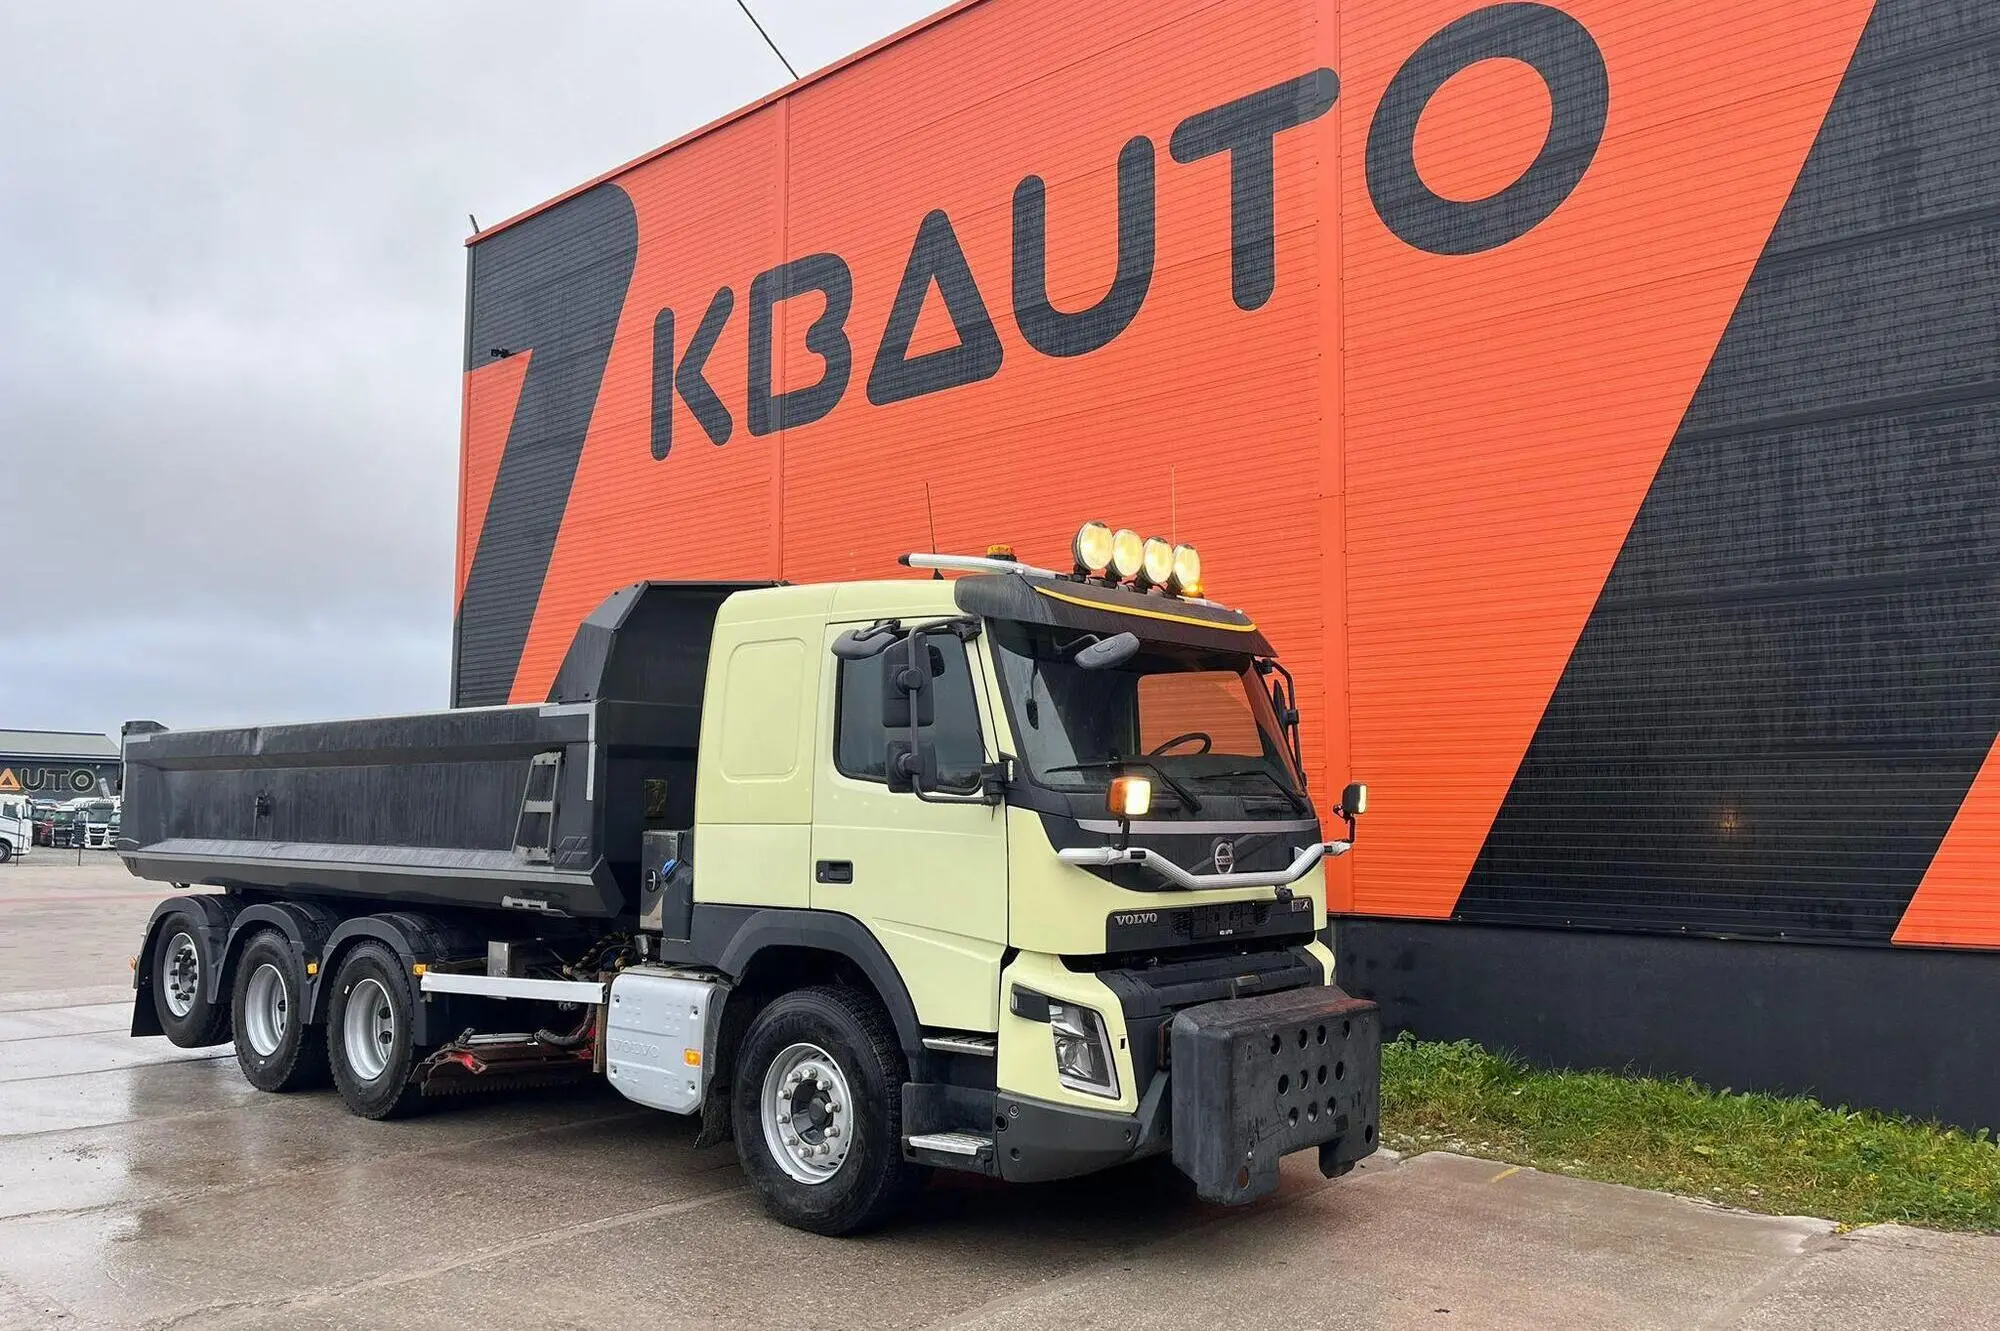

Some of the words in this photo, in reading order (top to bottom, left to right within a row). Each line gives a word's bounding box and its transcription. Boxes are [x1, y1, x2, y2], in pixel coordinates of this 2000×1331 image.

[651, 1, 1610, 462] KBAUTO
[1114, 912, 1158, 926] VOLVO
[611, 1039, 660, 1059] VOLVO
